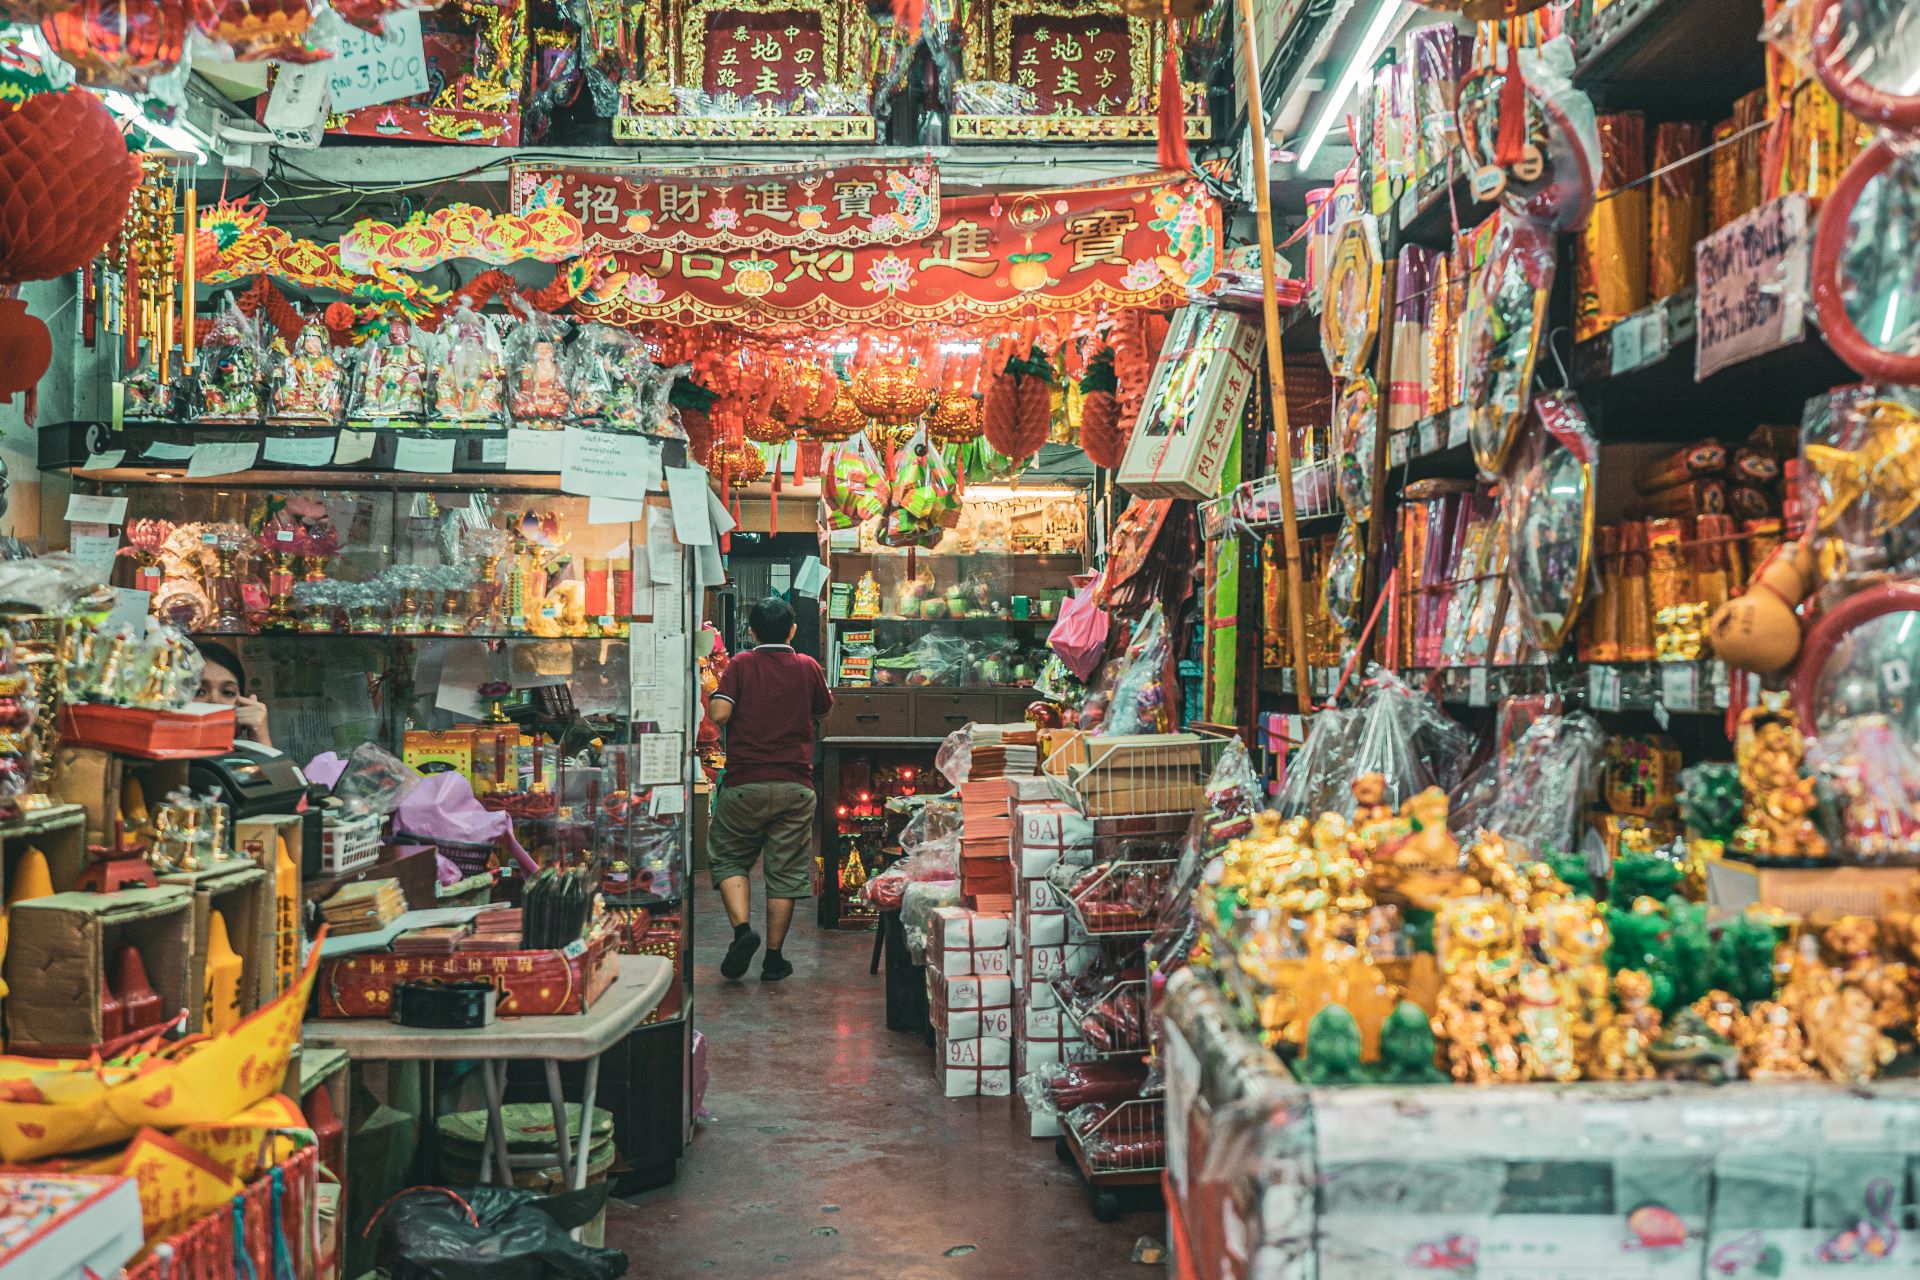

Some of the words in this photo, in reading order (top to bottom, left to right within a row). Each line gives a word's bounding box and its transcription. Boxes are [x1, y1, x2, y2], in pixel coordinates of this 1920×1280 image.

[357, 56, 420, 93] 3,200
[572, 177, 880, 225] 招財進寶
[1028, 819, 1056, 840] 9A
[979, 951, 1003, 971] 9A
[984, 1012, 1008, 1033] 9A
[951, 1041, 976, 1063] 9A
